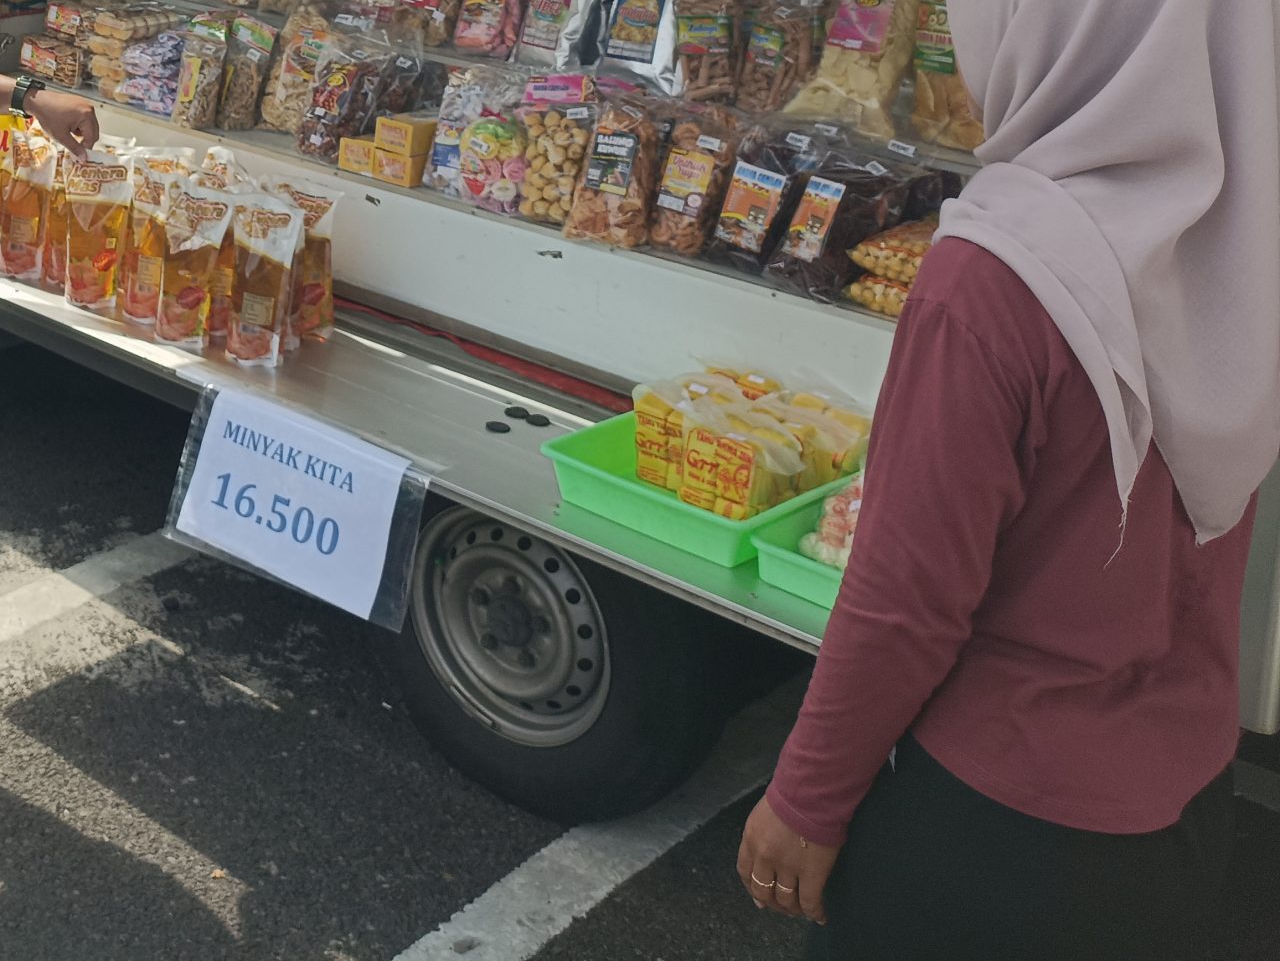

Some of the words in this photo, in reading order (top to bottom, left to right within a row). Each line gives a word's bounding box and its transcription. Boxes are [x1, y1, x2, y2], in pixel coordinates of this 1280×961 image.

[66, 179, 100, 195] Mas
[72, 163, 127, 181] Lentera
[223, 420, 302, 470] MINYAK
[304, 454, 354, 493] KITA
[211, 472, 340, 556] 16.500
